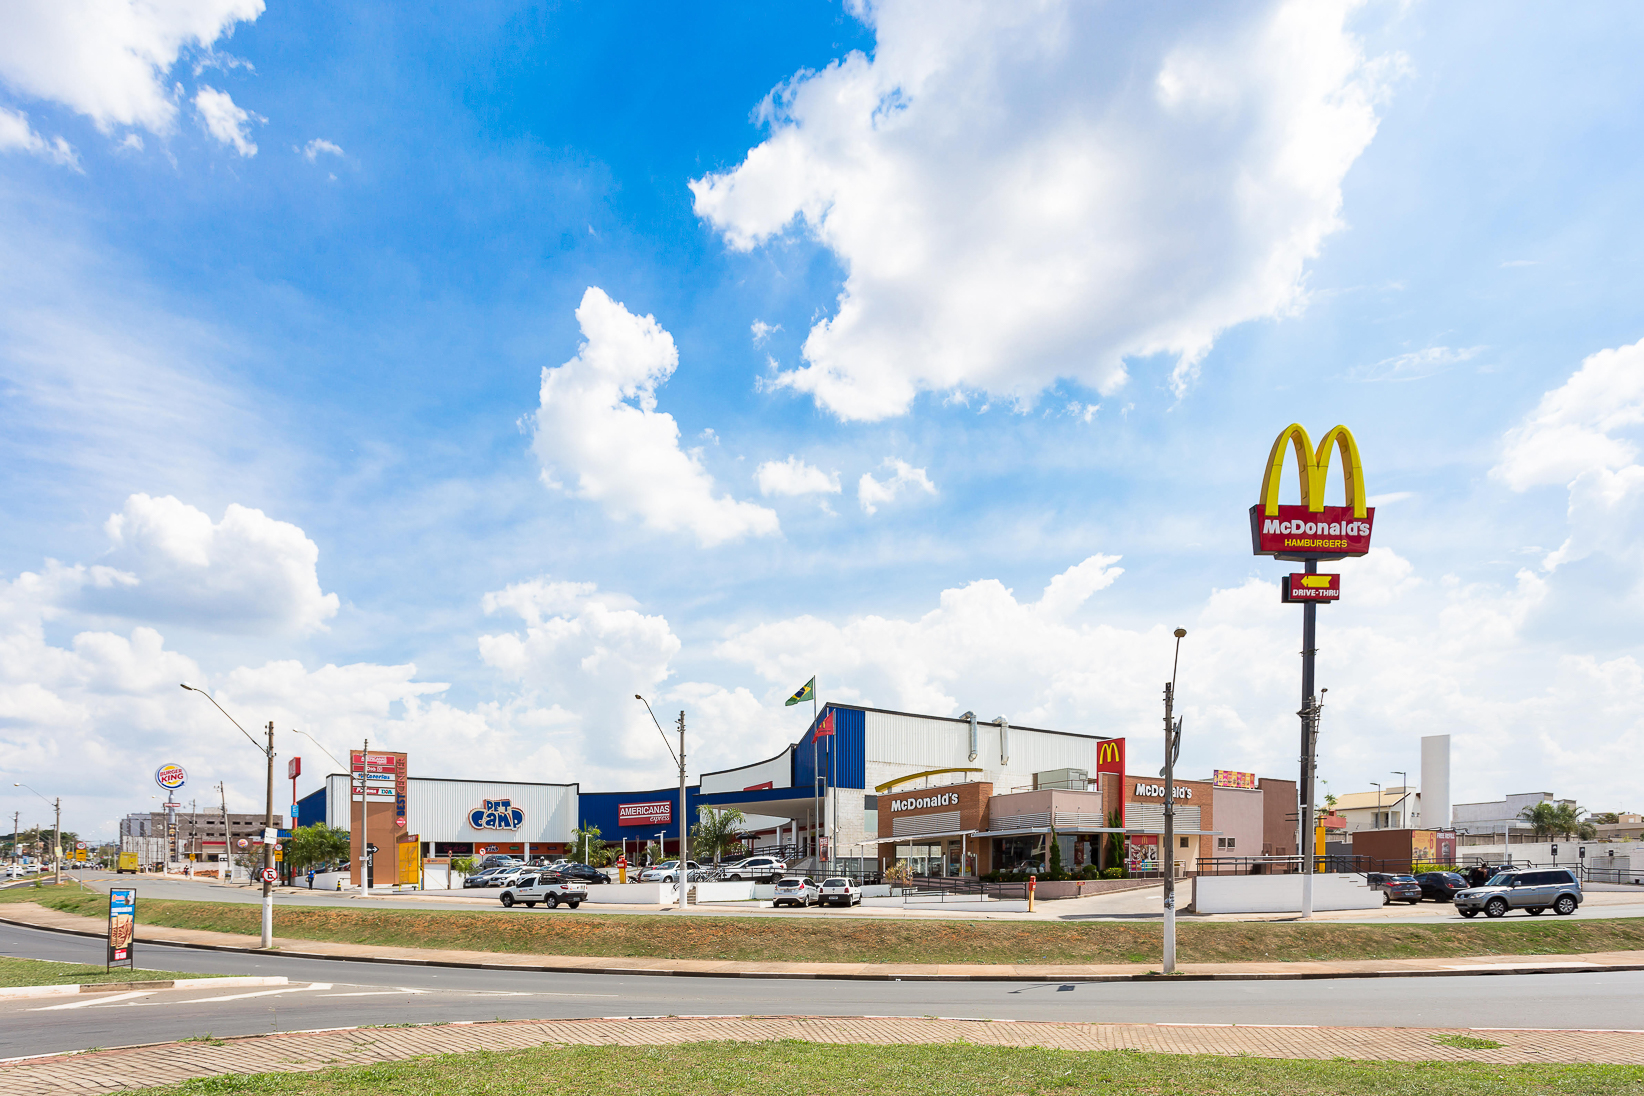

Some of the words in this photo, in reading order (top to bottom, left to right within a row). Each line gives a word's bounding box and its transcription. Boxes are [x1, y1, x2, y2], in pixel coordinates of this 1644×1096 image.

[1263, 519, 1370, 536] McDonald's
[1284, 538, 1348, 548] HAMBURGERS
[1292, 589, 1339, 597] DRIVE-THRU
[160, 769, 182, 777] BURGER
[161, 772, 184, 783] KING
[1135, 783, 1192, 799] McDoald's
[486, 800, 511, 812] PET
[891, 792, 959, 812] McDonald's
[620, 805, 670, 815] AMERICANAS
[649, 816, 670, 824] express
